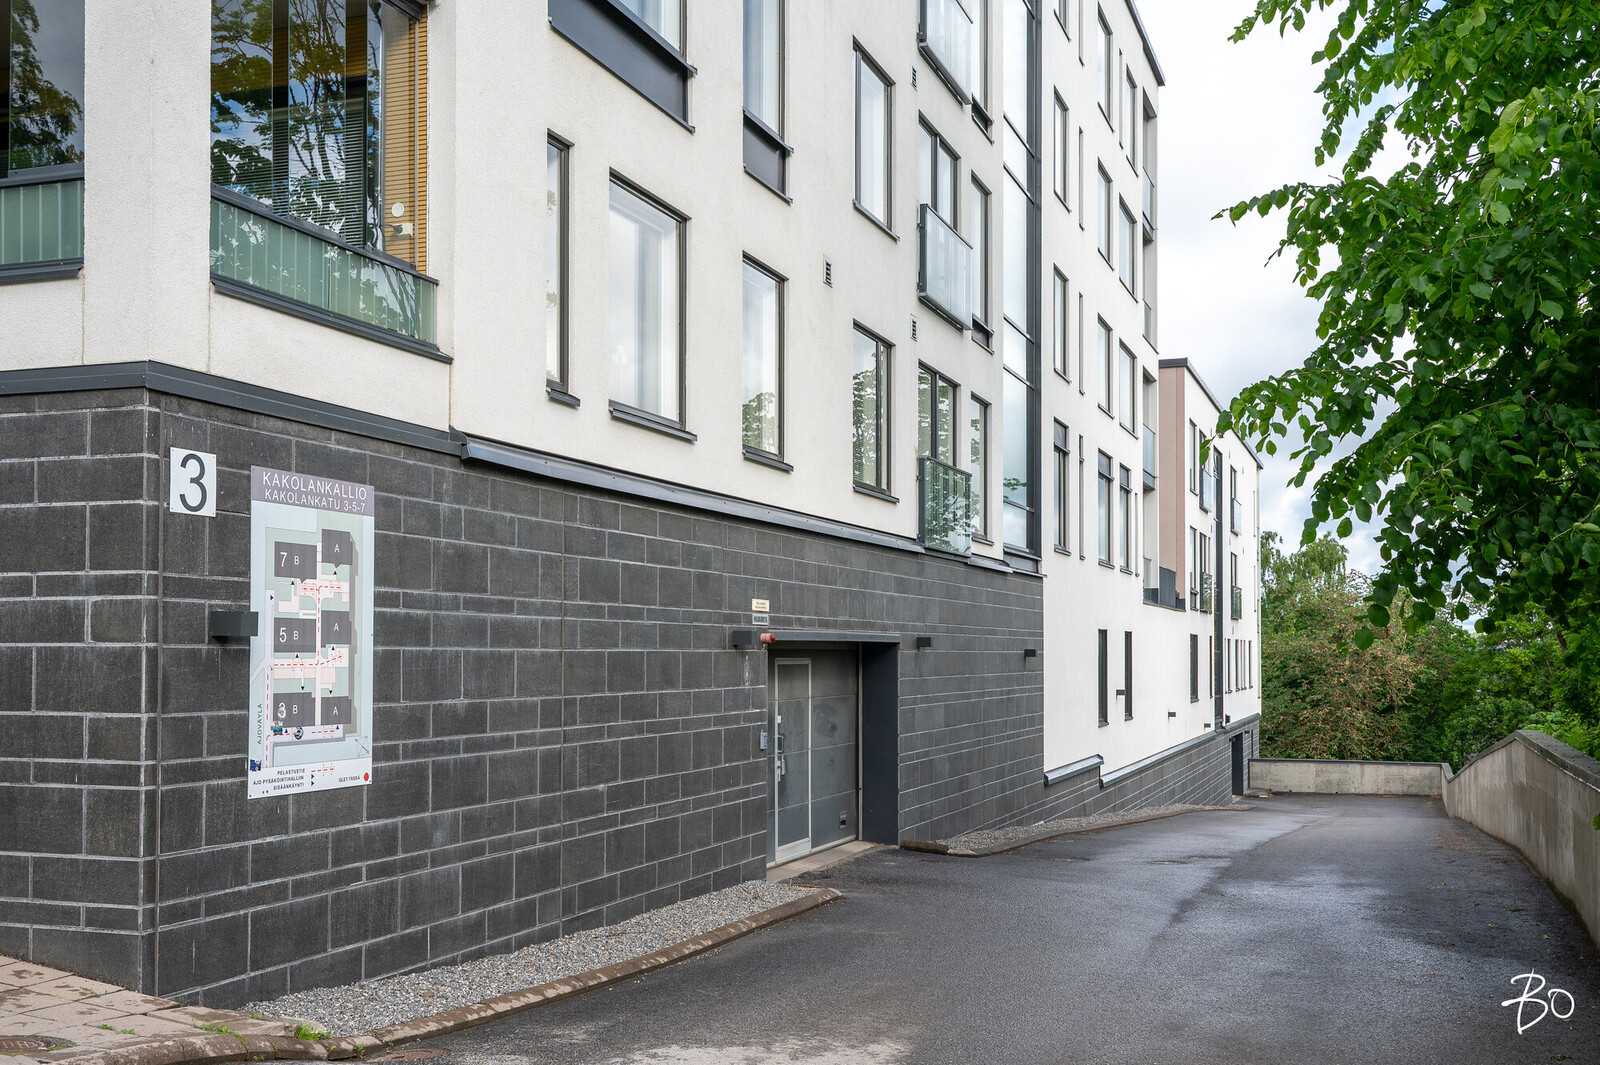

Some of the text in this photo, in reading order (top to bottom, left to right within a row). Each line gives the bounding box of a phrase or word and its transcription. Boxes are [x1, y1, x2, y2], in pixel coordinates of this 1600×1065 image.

[179, 453, 208, 512] 3
[262, 471, 367, 501] KAKOLANKALLIO
[265, 488, 366, 513] KAKOLANKATU 3-5-7
[334, 544, 340, 553] A
[280, 551, 300, 567] 7 B
[279, 627, 299, 642] 5 B
[333, 623, 339, 631] A
[292, 704, 298, 714] B
[333, 706, 339, 715] A
